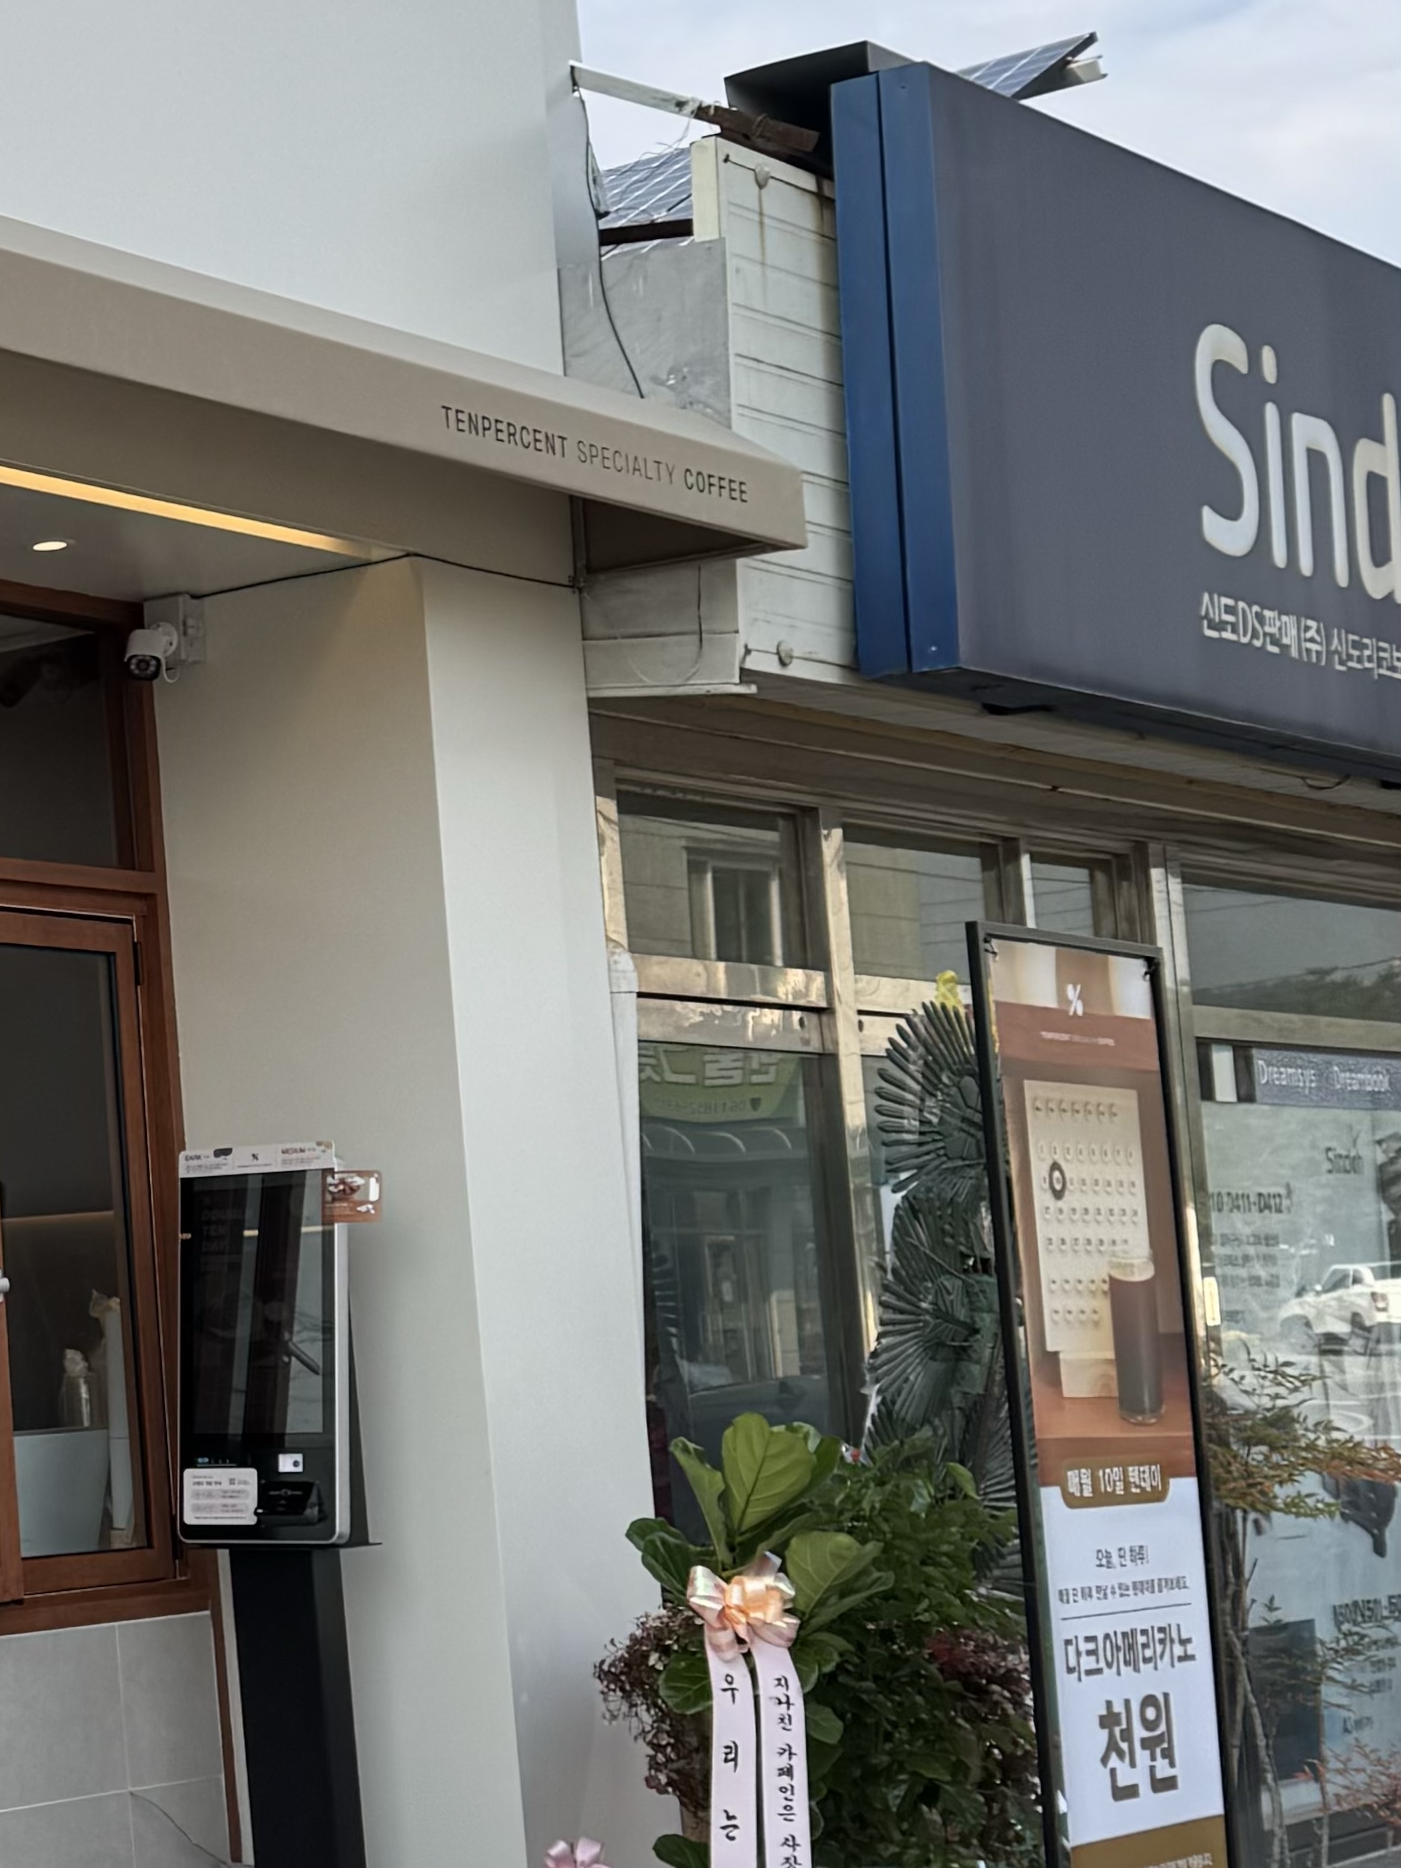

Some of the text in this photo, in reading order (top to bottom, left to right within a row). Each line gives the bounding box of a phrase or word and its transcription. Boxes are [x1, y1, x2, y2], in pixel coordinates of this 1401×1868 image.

[441, 404, 748, 504] TENPERCENT SPECIALTY COFFEE
[1200, 591, 1327, 667] 신도DS판매(주)
[1066, 1463, 1162, 1498] 매월 10일 텐데이
[1063, 1623, 1197, 1683] 다크아메리카노
[773, 1675, 795, 1733] 지나친
[775, 1743, 798, 1823] 카페인은
[1098, 1691, 1180, 1803] 천원
